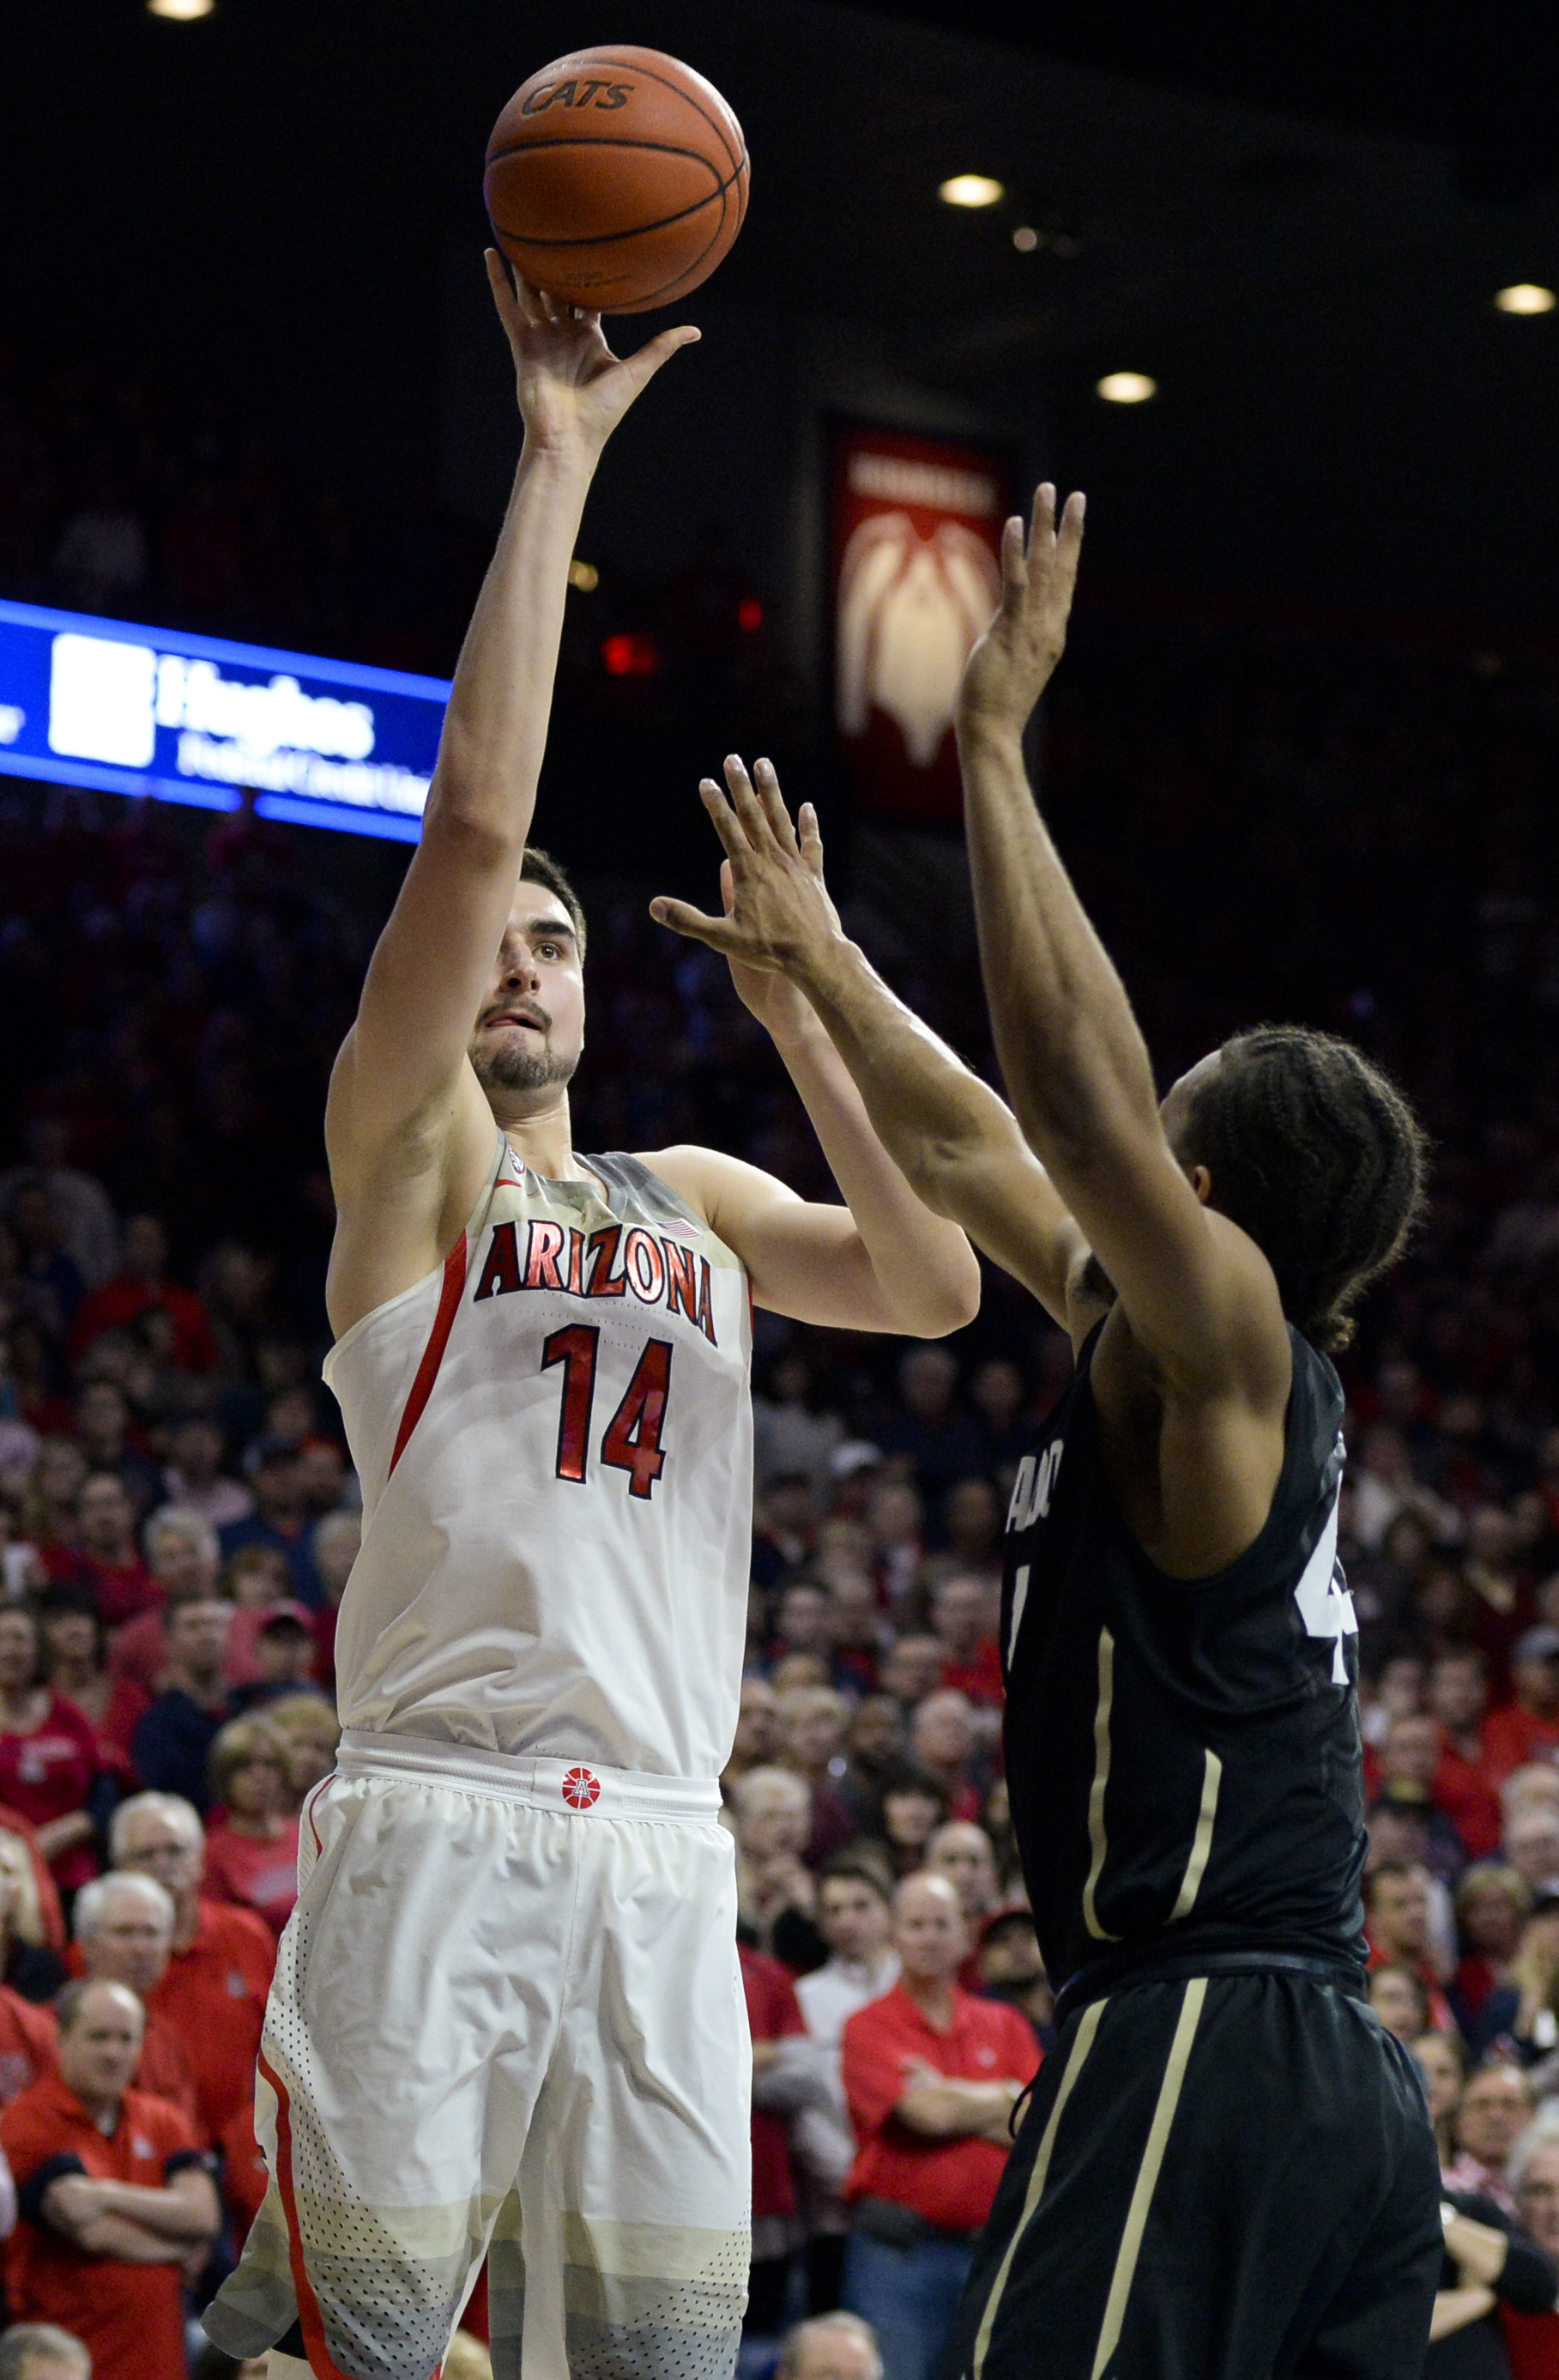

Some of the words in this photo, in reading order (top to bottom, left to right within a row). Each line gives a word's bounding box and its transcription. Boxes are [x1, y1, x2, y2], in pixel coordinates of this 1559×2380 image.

[521, 79, 635, 118] CATS
[473, 1219, 719, 1347] ARIZONA
[540, 1323, 674, 1501] 14
